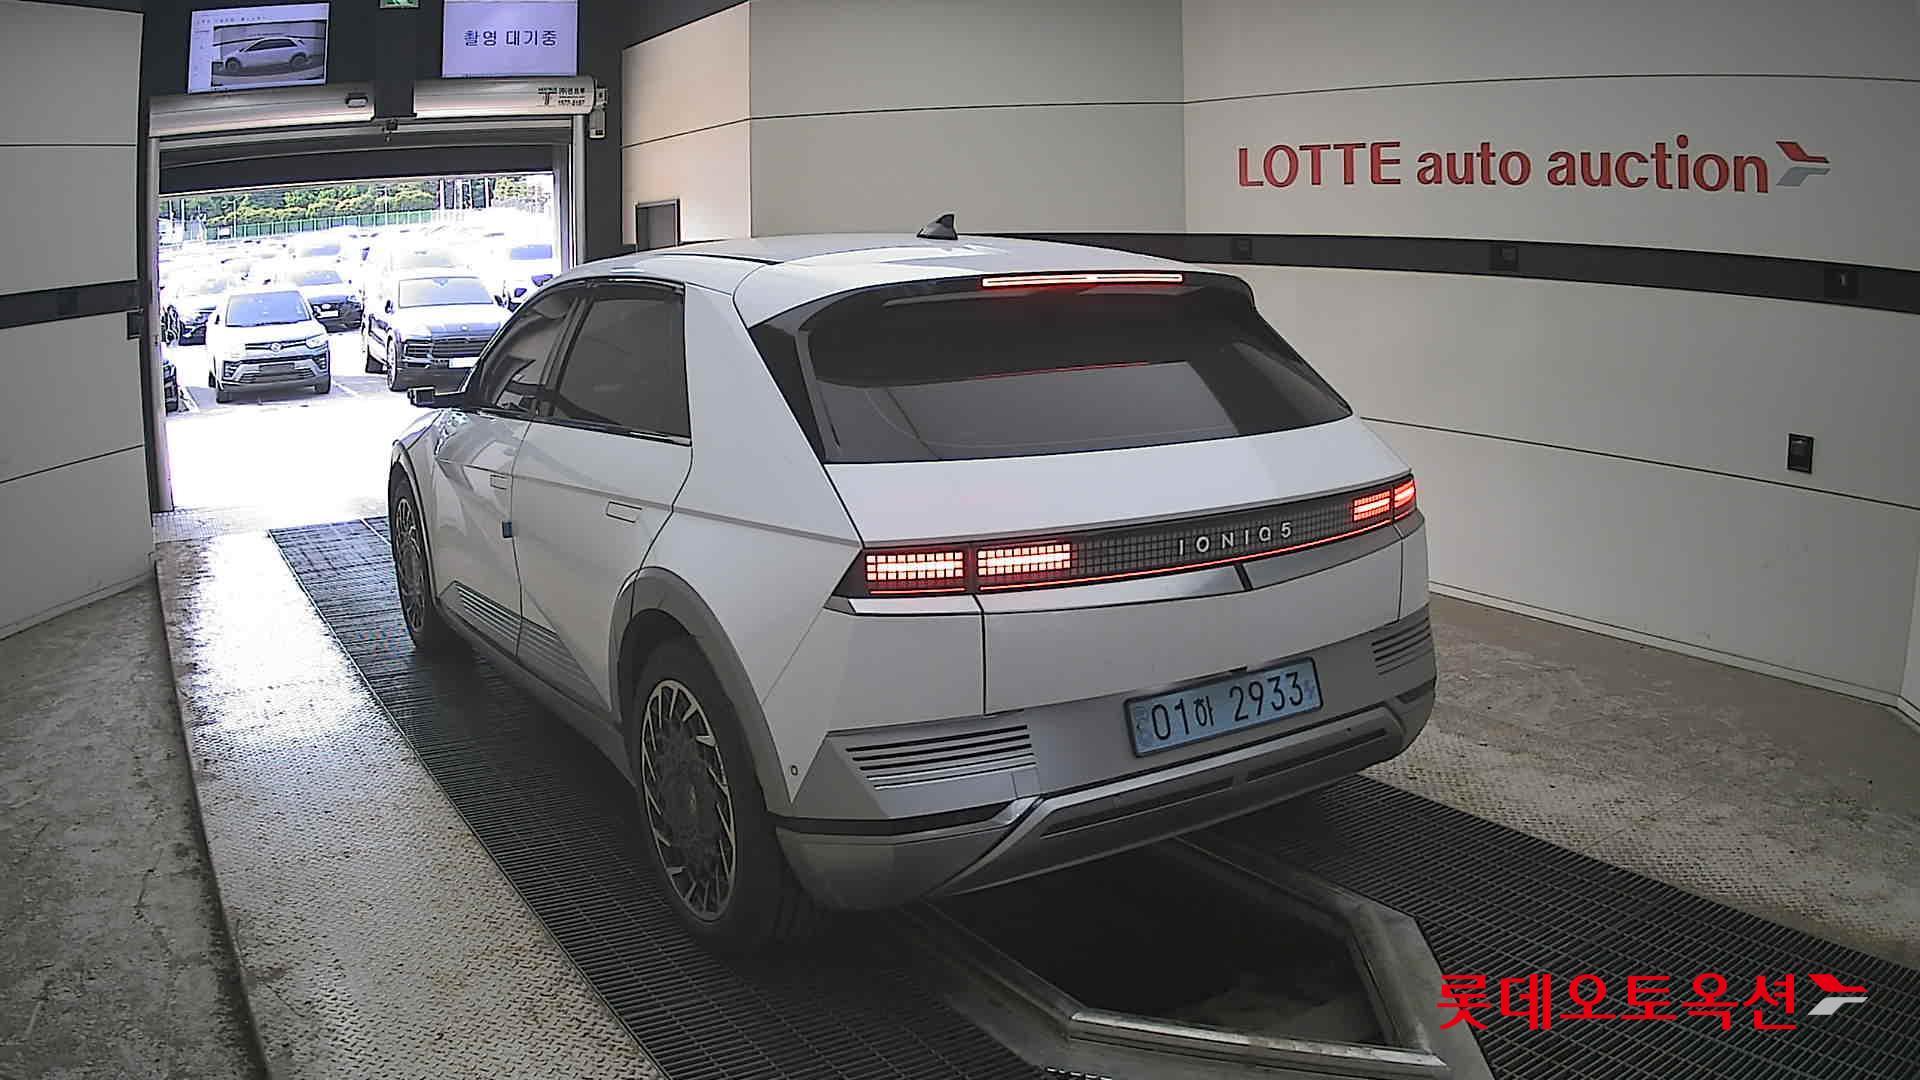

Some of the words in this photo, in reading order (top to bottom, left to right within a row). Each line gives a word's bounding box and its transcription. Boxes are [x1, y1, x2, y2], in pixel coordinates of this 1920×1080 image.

[464, 30, 497, 46] 촬영
[505, 29, 558, 46] 대기중
[1238, 141, 1401, 188] LOTTE
[1416, 142, 1532, 186] auto
[1547, 134, 1769, 194] auction
[1151, 696, 1215, 740] 01하
[1229, 672, 1304, 722] 2933
